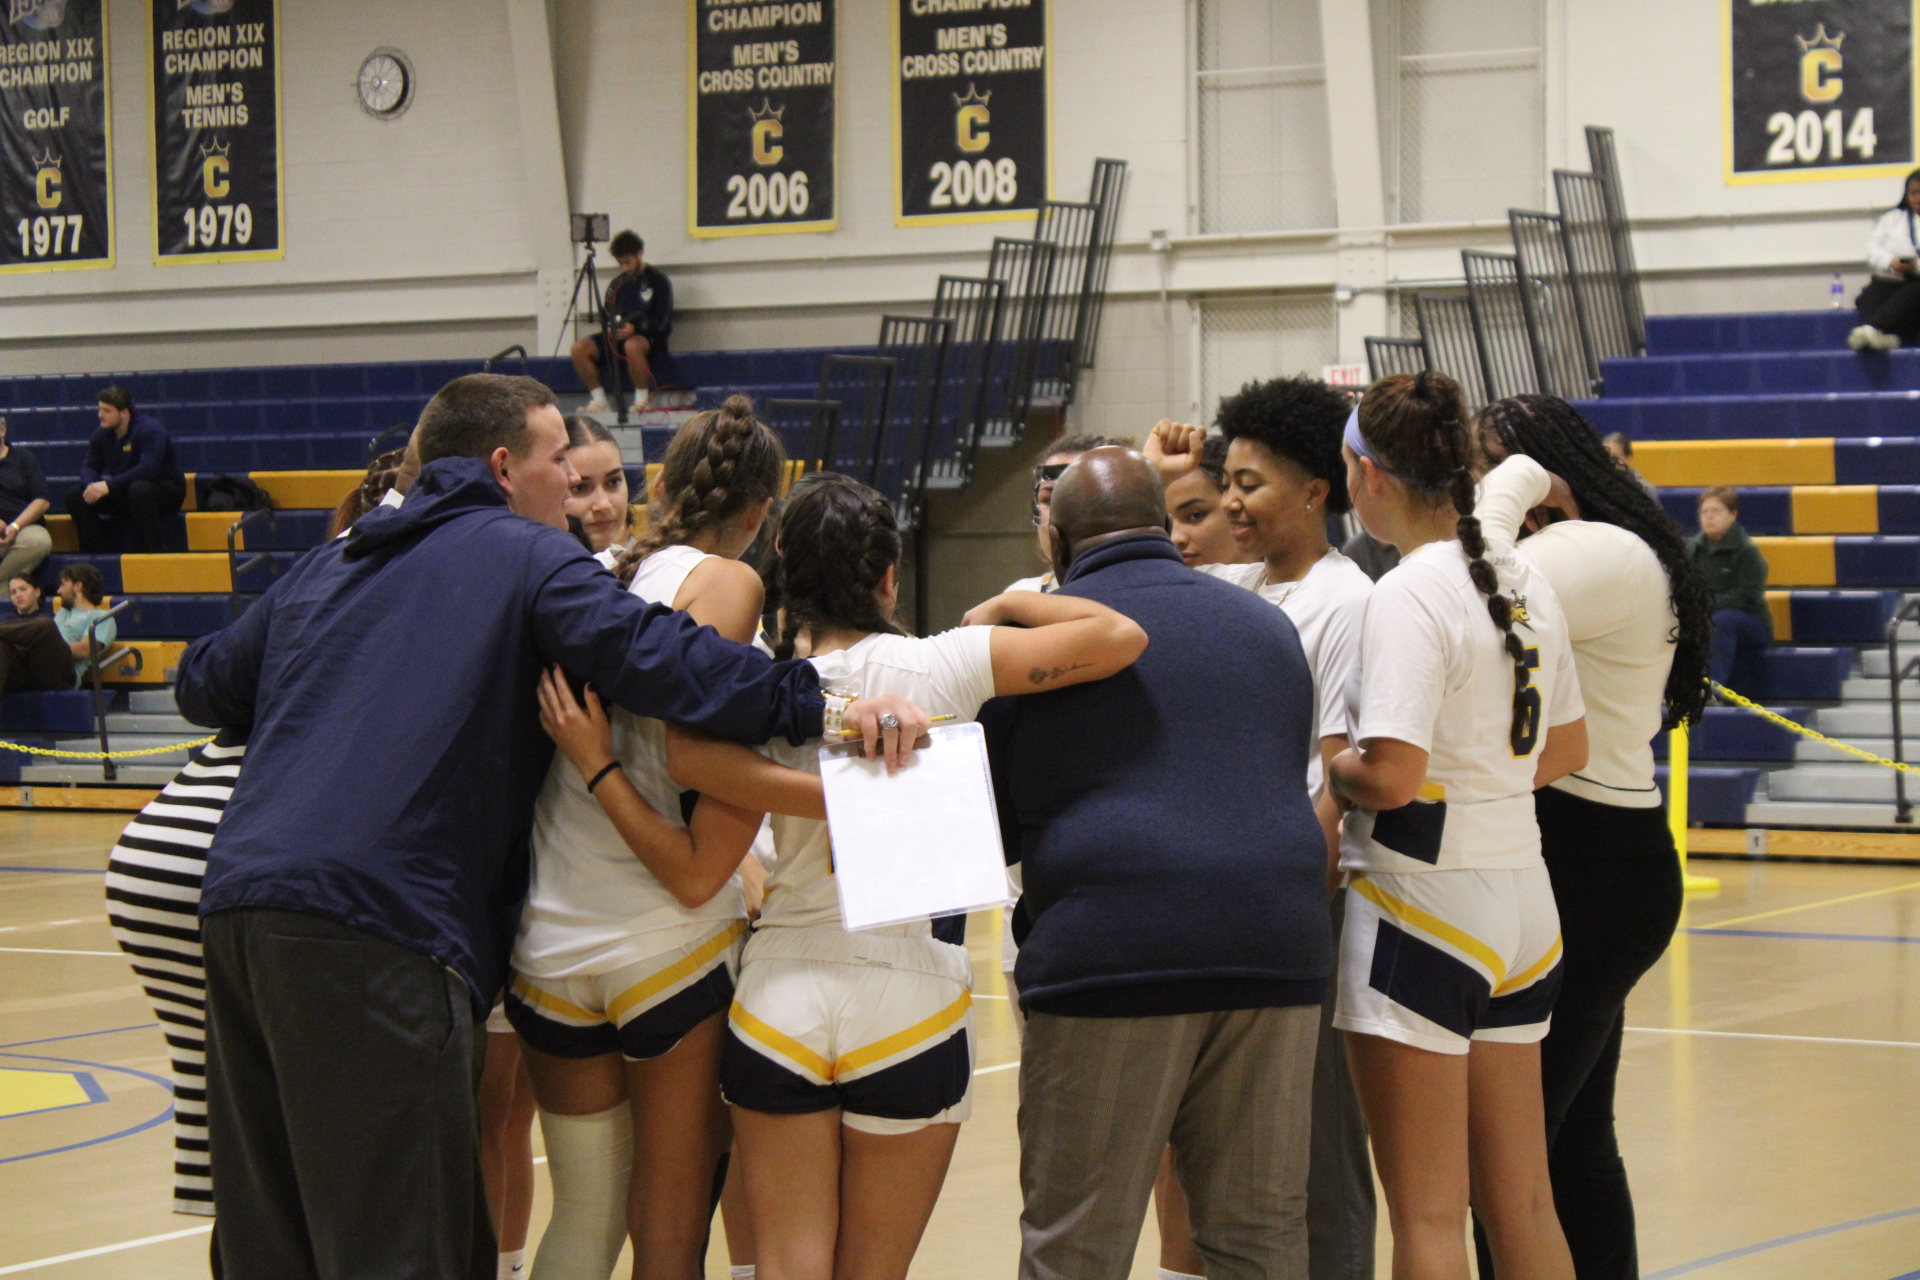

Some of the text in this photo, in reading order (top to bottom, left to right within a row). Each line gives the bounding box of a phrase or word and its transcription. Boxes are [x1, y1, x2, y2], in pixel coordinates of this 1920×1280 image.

[709, 1, 822, 32] CHAMPION
[0, 36, 95, 64] REGION XIX
[162, 22, 266, 50] REGION XIX
[937, 22, 1008, 51] MEN'S
[165, 46, 263, 75] CHAMPION
[733, 39, 800, 67] MEN'S
[902, 46, 1045, 78] CROSS COUNTRY
[0, 60, 93, 88] CHAMPION
[700, 62, 834, 94] CROSS COUNTRY
[1802, 48, 1844, 104] C
[186, 82, 244, 106] MEN'S
[23, 107, 70, 129] GOLF
[181, 104, 250, 129] TENNIS
[957, 104, 990, 152] C
[752, 118, 784, 165] C
[1767, 107, 1877, 163] 2014
[36, 167, 62, 209] C
[203, 155, 230, 198] C
[929, 157, 1018, 207] 2008
[727, 170, 810, 219] 2006
[18, 214, 83, 256] 1977
[184, 203, 253, 246] 1979
